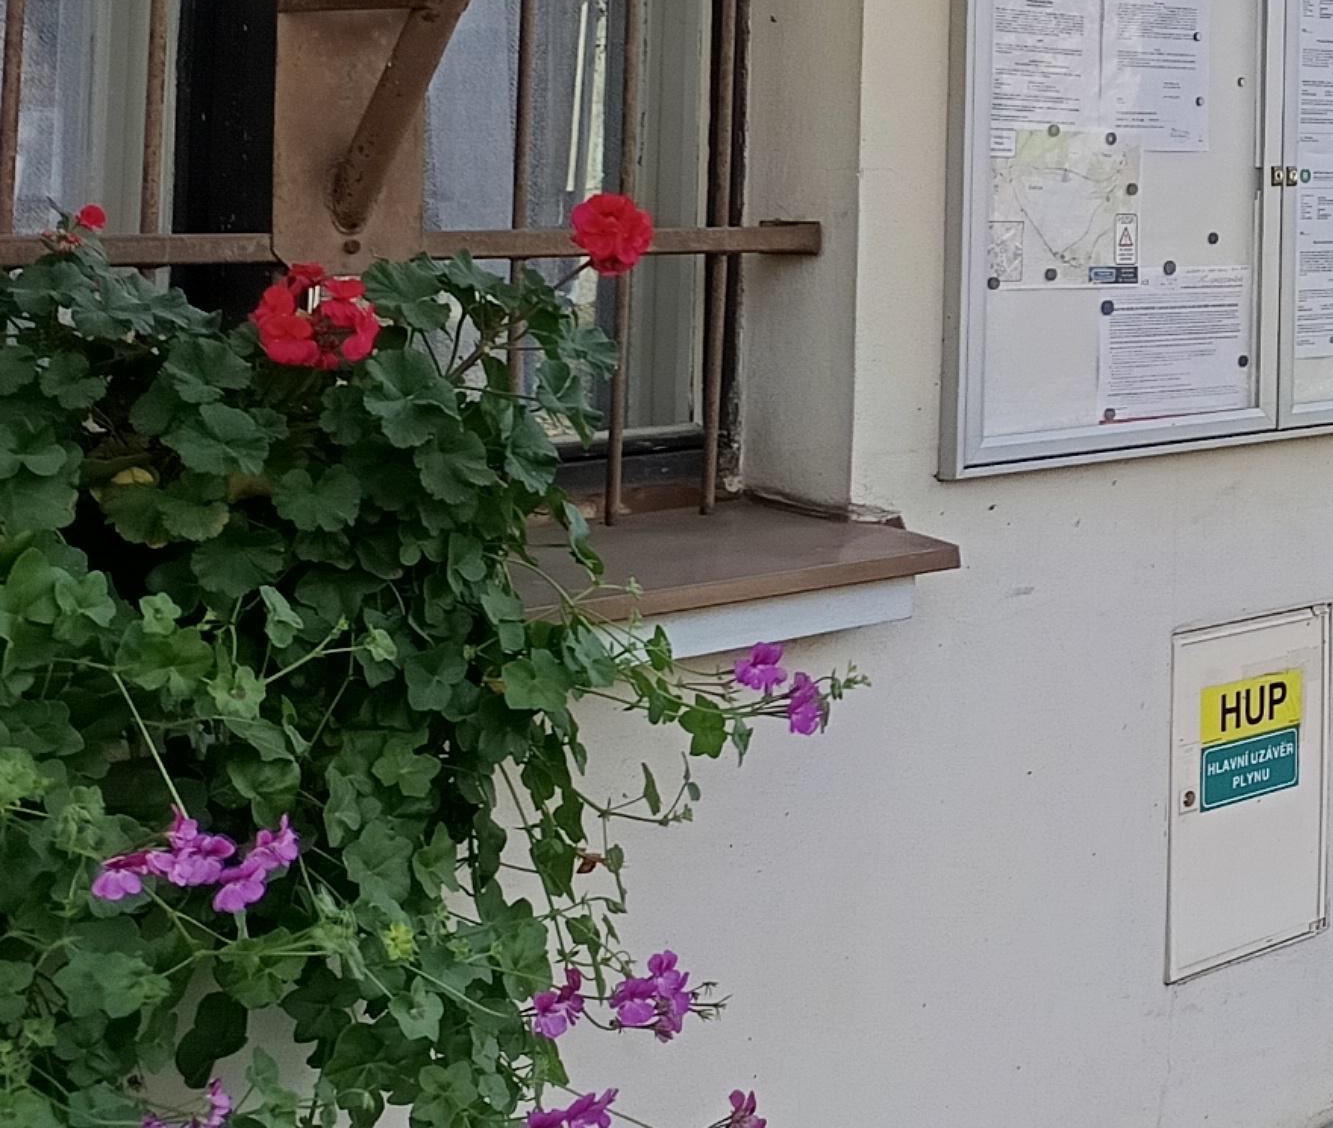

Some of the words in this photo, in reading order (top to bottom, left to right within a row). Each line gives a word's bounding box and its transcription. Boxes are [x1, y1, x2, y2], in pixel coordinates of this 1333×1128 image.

[1221, 681, 1286, 731] HUP
[1208, 751, 1249, 776] HLAVNÍ
[1251, 742, 1293, 764] UZÁVĚR
[1233, 769, 1270, 788] PLYNU
